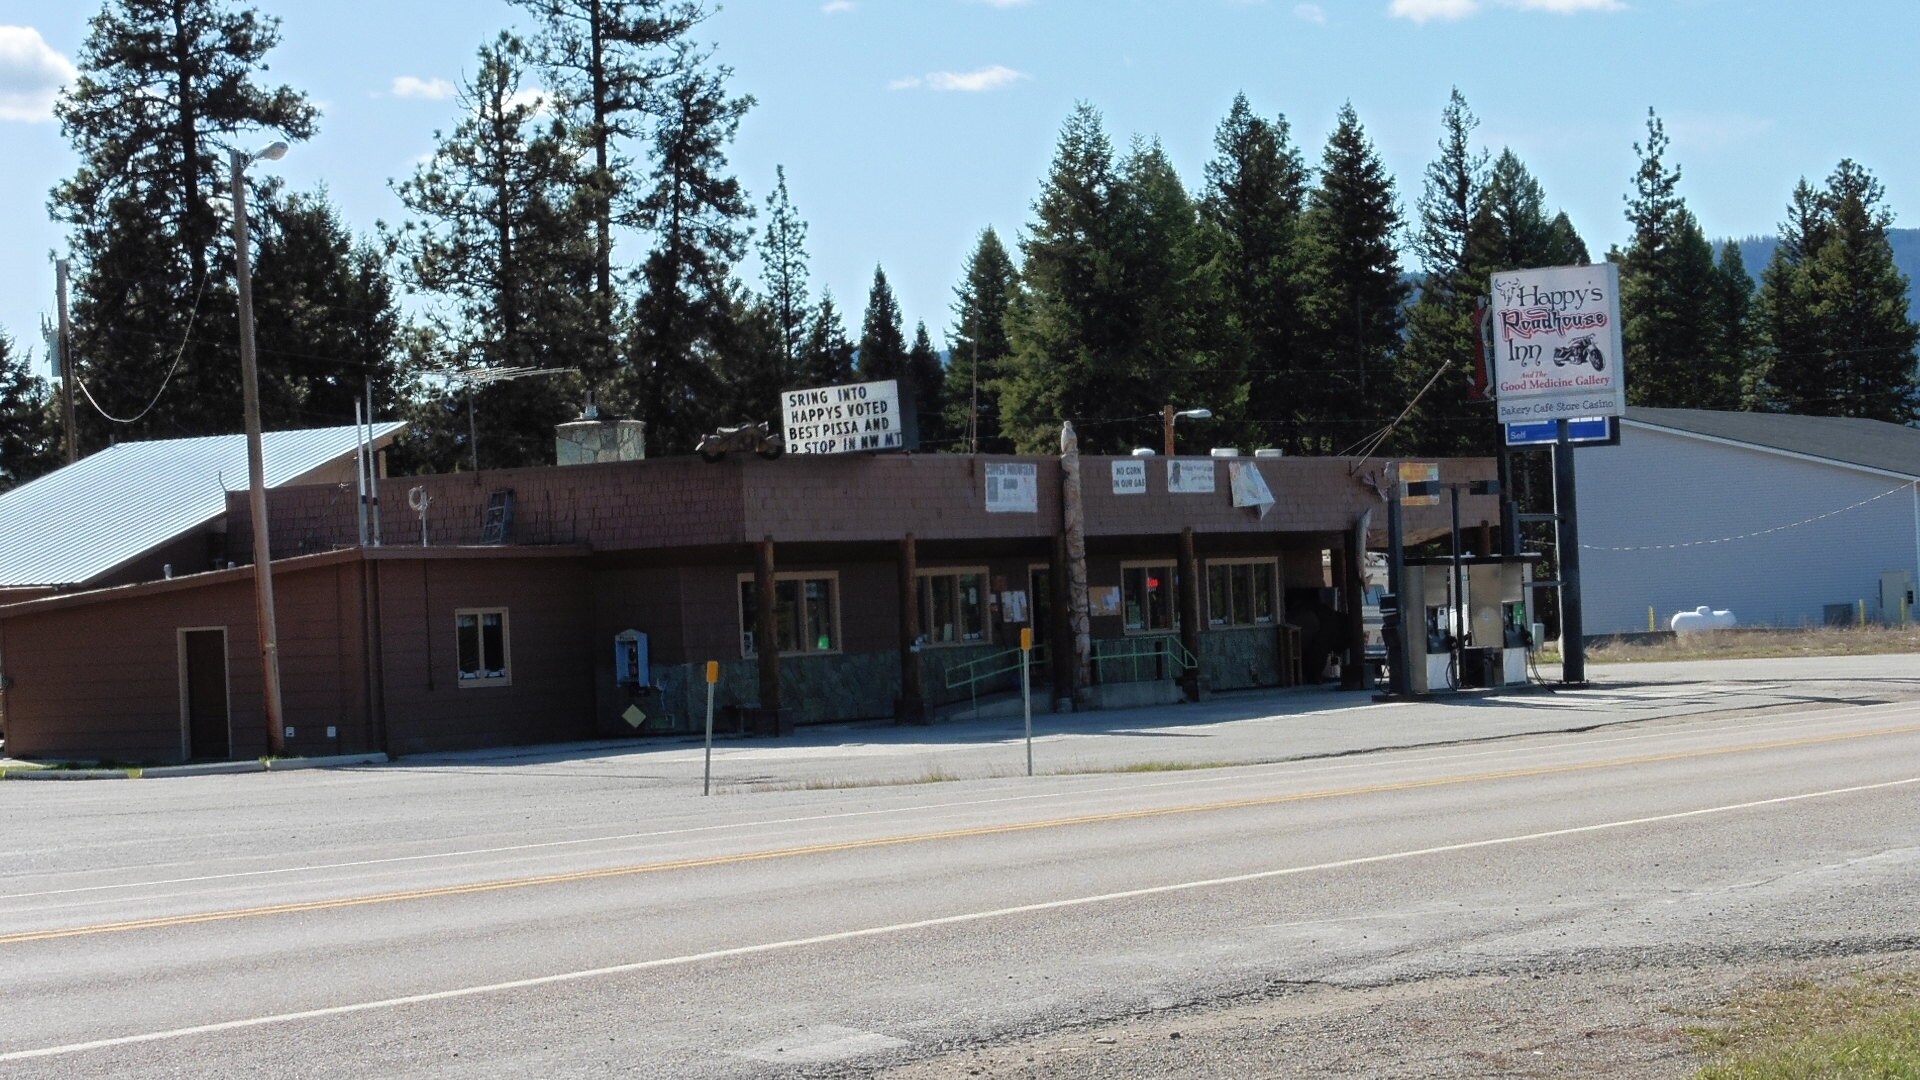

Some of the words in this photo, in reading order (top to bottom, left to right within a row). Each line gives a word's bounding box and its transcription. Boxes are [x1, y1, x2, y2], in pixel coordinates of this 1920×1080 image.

[1517, 281, 1604, 311] Happy's
[1499, 306, 1607, 340] Roadhouse
[1508, 338, 1542, 367] Inn
[1501, 380, 1527, 392] Good
[1529, 378, 1573, 390] Medicine
[1575, 376, 1610, 387] Gallery
[789, 391, 828, 407] SRING
[838, 386, 867, 402] INTO
[791, 405, 842, 423] HAPPYS
[847, 401, 888, 417] VOTED
[1501, 406, 1532, 416] Bakery
[1556, 402, 1580, 411] Store
[1582, 400, 1614, 410] Casino
[789, 425, 820, 440] BEST
[865, 417, 889, 431] AND
[1510, 431, 1526, 440] Self
[804, 439, 836, 454] STOP
[844, 437, 856, 450] IN
[861, 435, 879, 448] NW
[884, 433, 902, 445] MT
